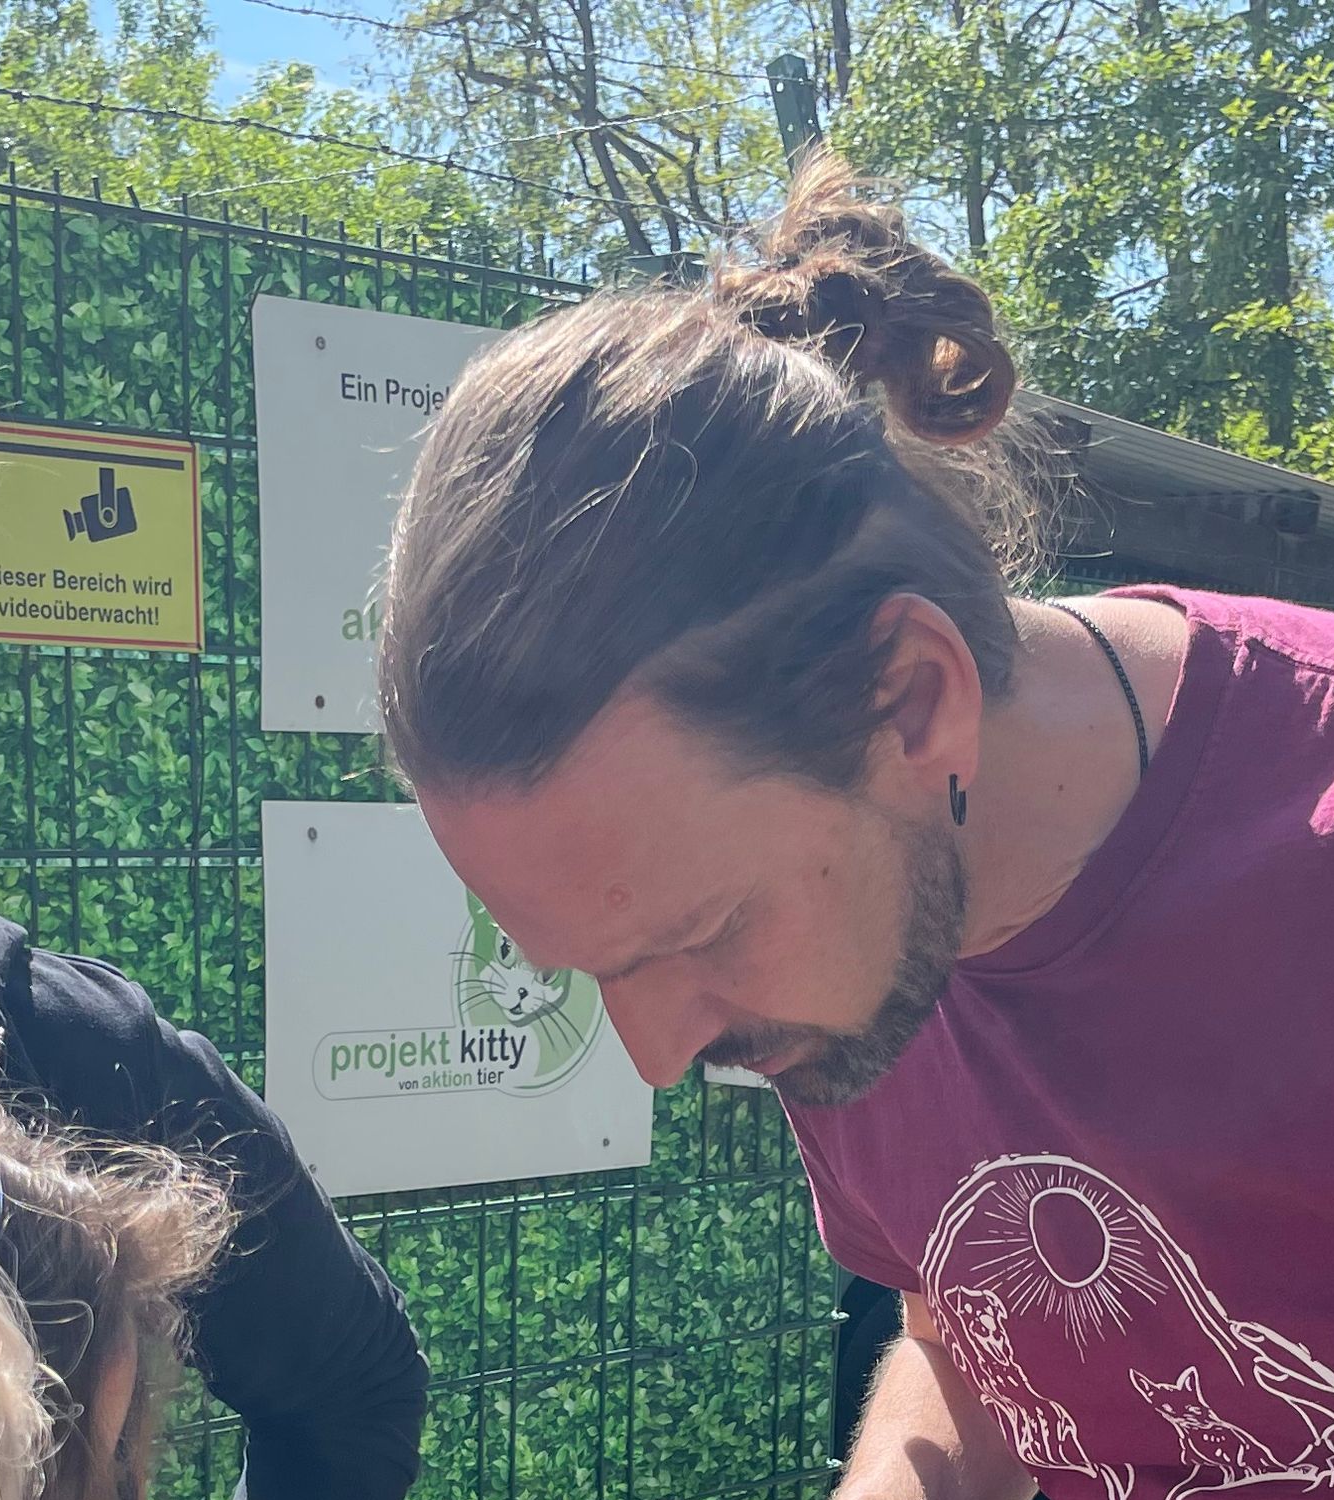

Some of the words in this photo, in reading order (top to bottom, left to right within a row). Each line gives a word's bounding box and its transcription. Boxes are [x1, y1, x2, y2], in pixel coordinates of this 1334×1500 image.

[340, 372, 377, 404] Ein
[53, 569, 128, 595] Bereich
[132, 576, 173, 597] wird
[330, 1031, 451, 1081] projekt
[459, 1028, 527, 1070] kitty
[398, 1077, 420, 1091] von
[421, 1069, 473, 1088] aktion
[476, 1068, 505, 1086] tier
